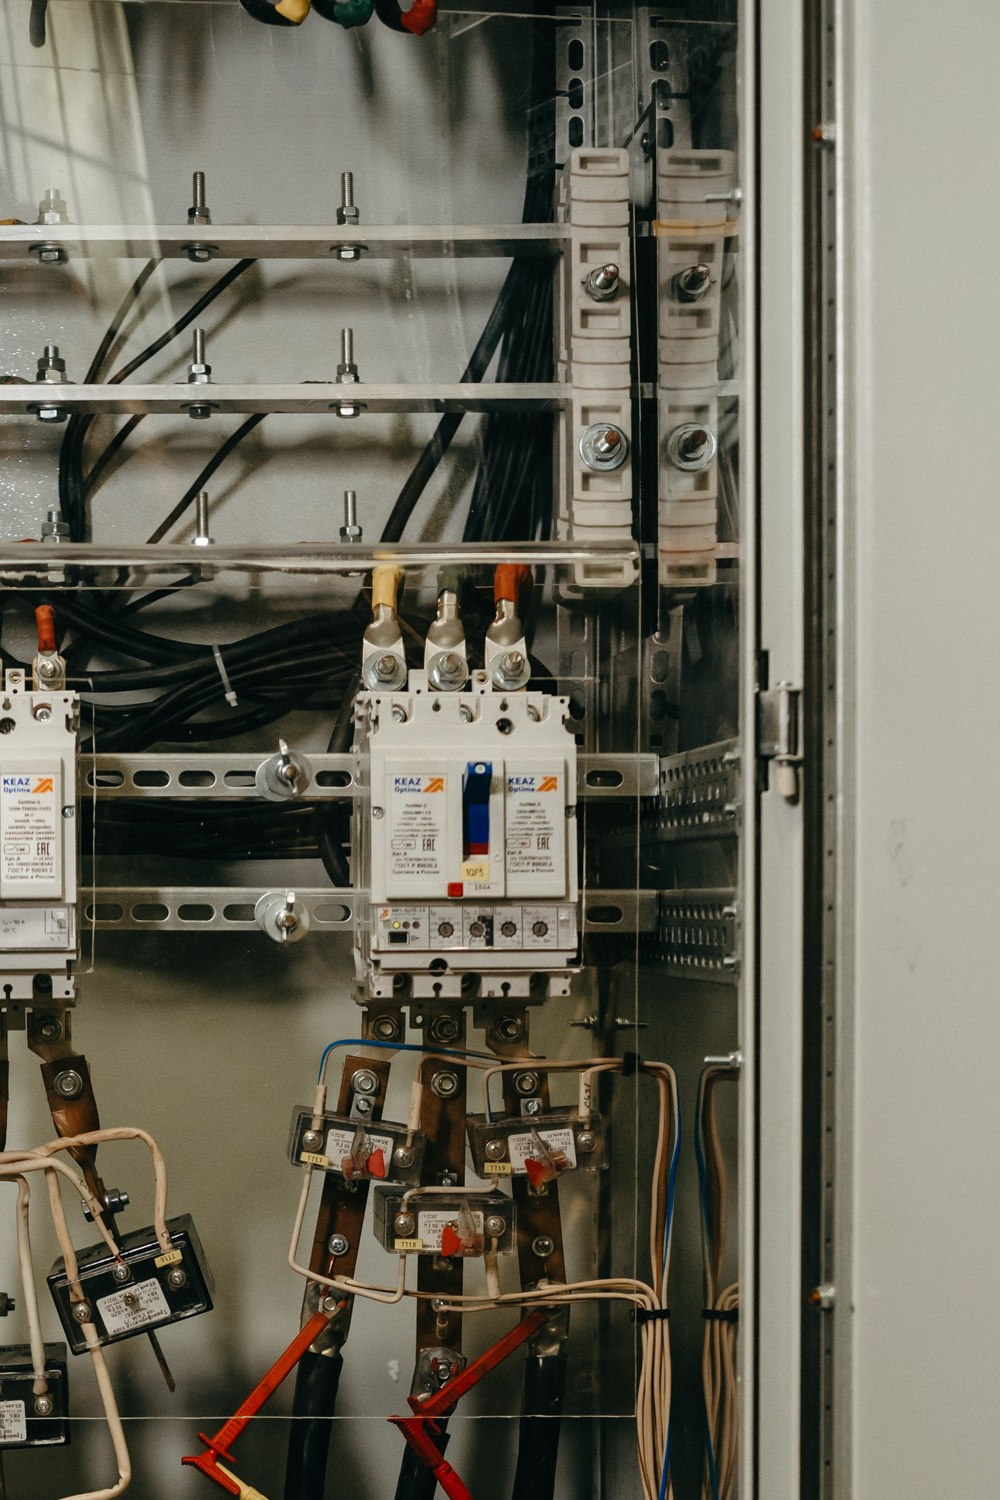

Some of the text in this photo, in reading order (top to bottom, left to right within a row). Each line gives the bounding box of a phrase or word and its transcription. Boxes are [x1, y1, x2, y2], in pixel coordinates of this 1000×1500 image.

[3, 778, 30, 786] KEAZ
[508, 777, 535, 785] KEAZ
[37, 842, 50, 855] EAC
[422, 839, 435, 851] EAC
[537, 837, 550, 850] EAC
[466, 868, 484, 876] 1QF5
